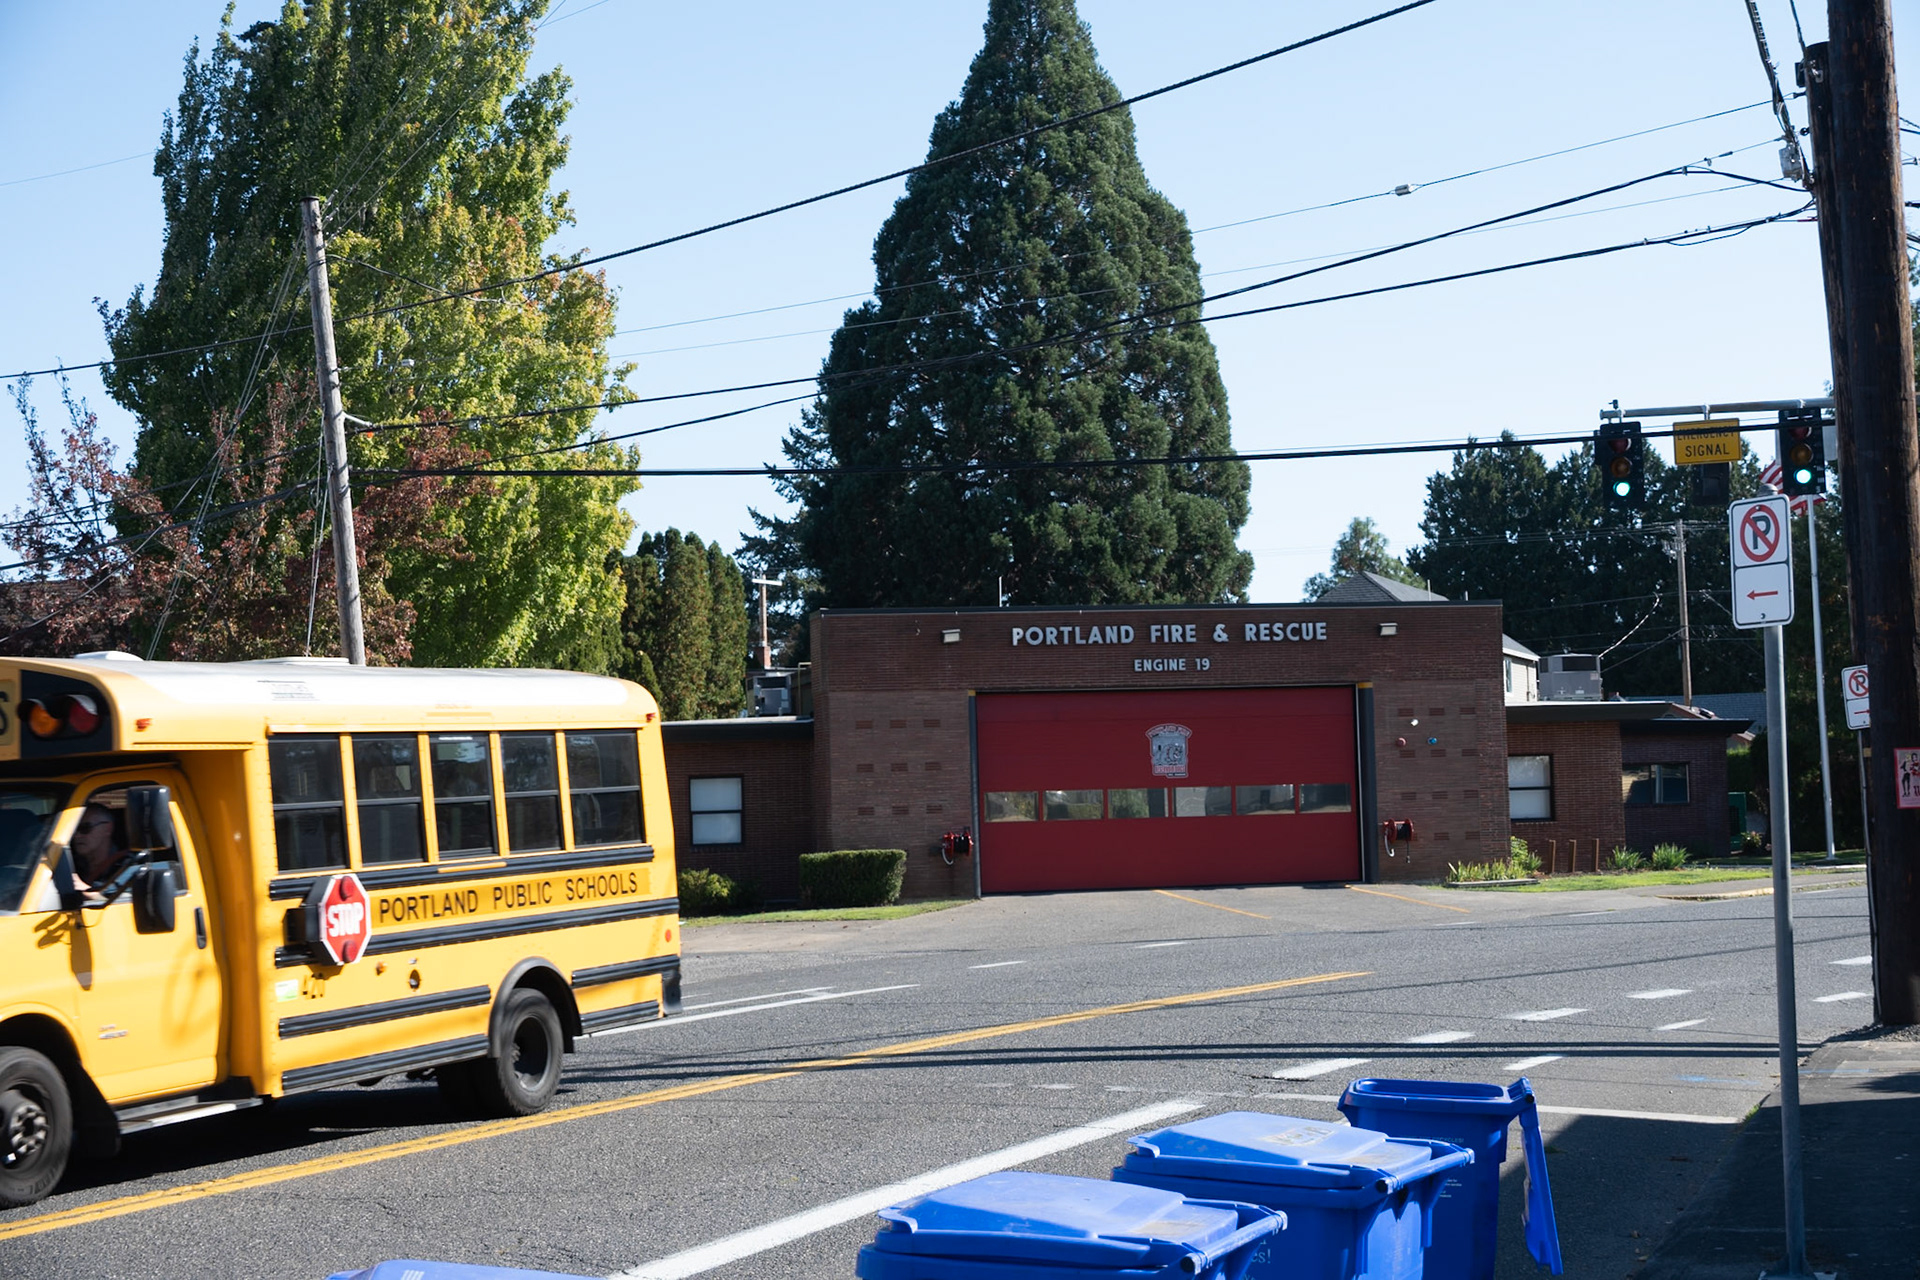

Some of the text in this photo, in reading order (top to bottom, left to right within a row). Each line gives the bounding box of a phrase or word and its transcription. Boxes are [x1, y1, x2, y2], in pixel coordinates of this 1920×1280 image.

[1685, 443, 1730, 458] SIGNAL
[1012, 622, 1327, 646] PORTLAND FIRE & RESCUE
[1134, 657, 1211, 672] ENGINE 19
[380, 872, 638, 923] PORTLAND PUBLIC SCHOOLS
[327, 902, 364, 937] STOP
